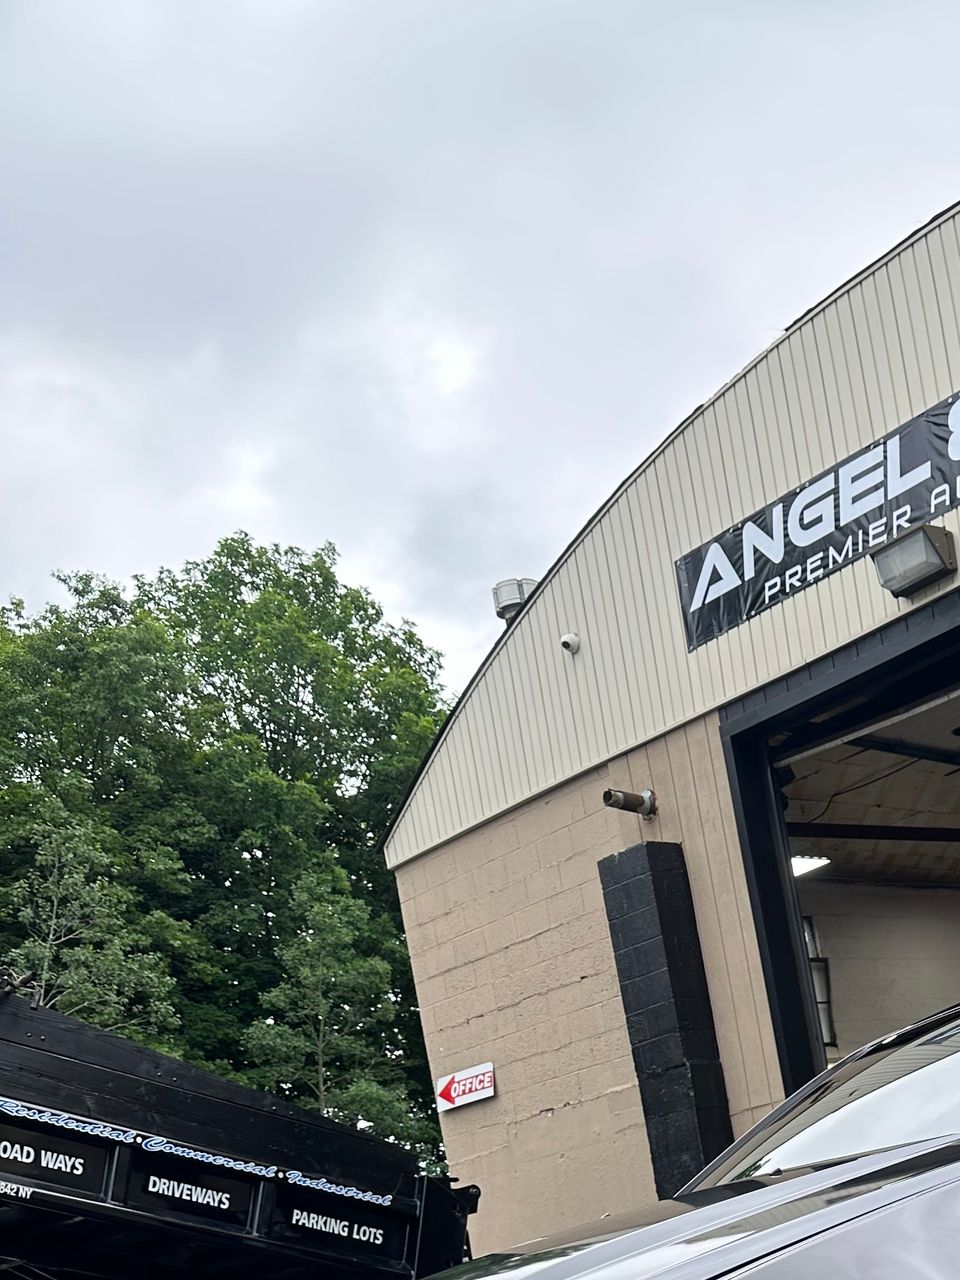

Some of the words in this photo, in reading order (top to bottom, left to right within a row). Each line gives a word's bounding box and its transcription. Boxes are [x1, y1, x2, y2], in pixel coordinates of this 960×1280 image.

[690, 434, 932, 613] ANGEL
[763, 503, 912, 604] PREMIER
[450, 1072, 493, 1098] OFFICE
[0, 1100, 135, 1143] Residential
[142, 1136, 278, 1178] Commercial
[286, 1171, 393, 1206] Industrial
[40, 1149, 84, 1175] WAYS
[18, 1186, 33, 1199] NY
[147, 1175, 231, 1210] DRIVEWAYS
[291, 1209, 349, 1237] PARKING
[352, 1223, 384, 1245] LOTS
